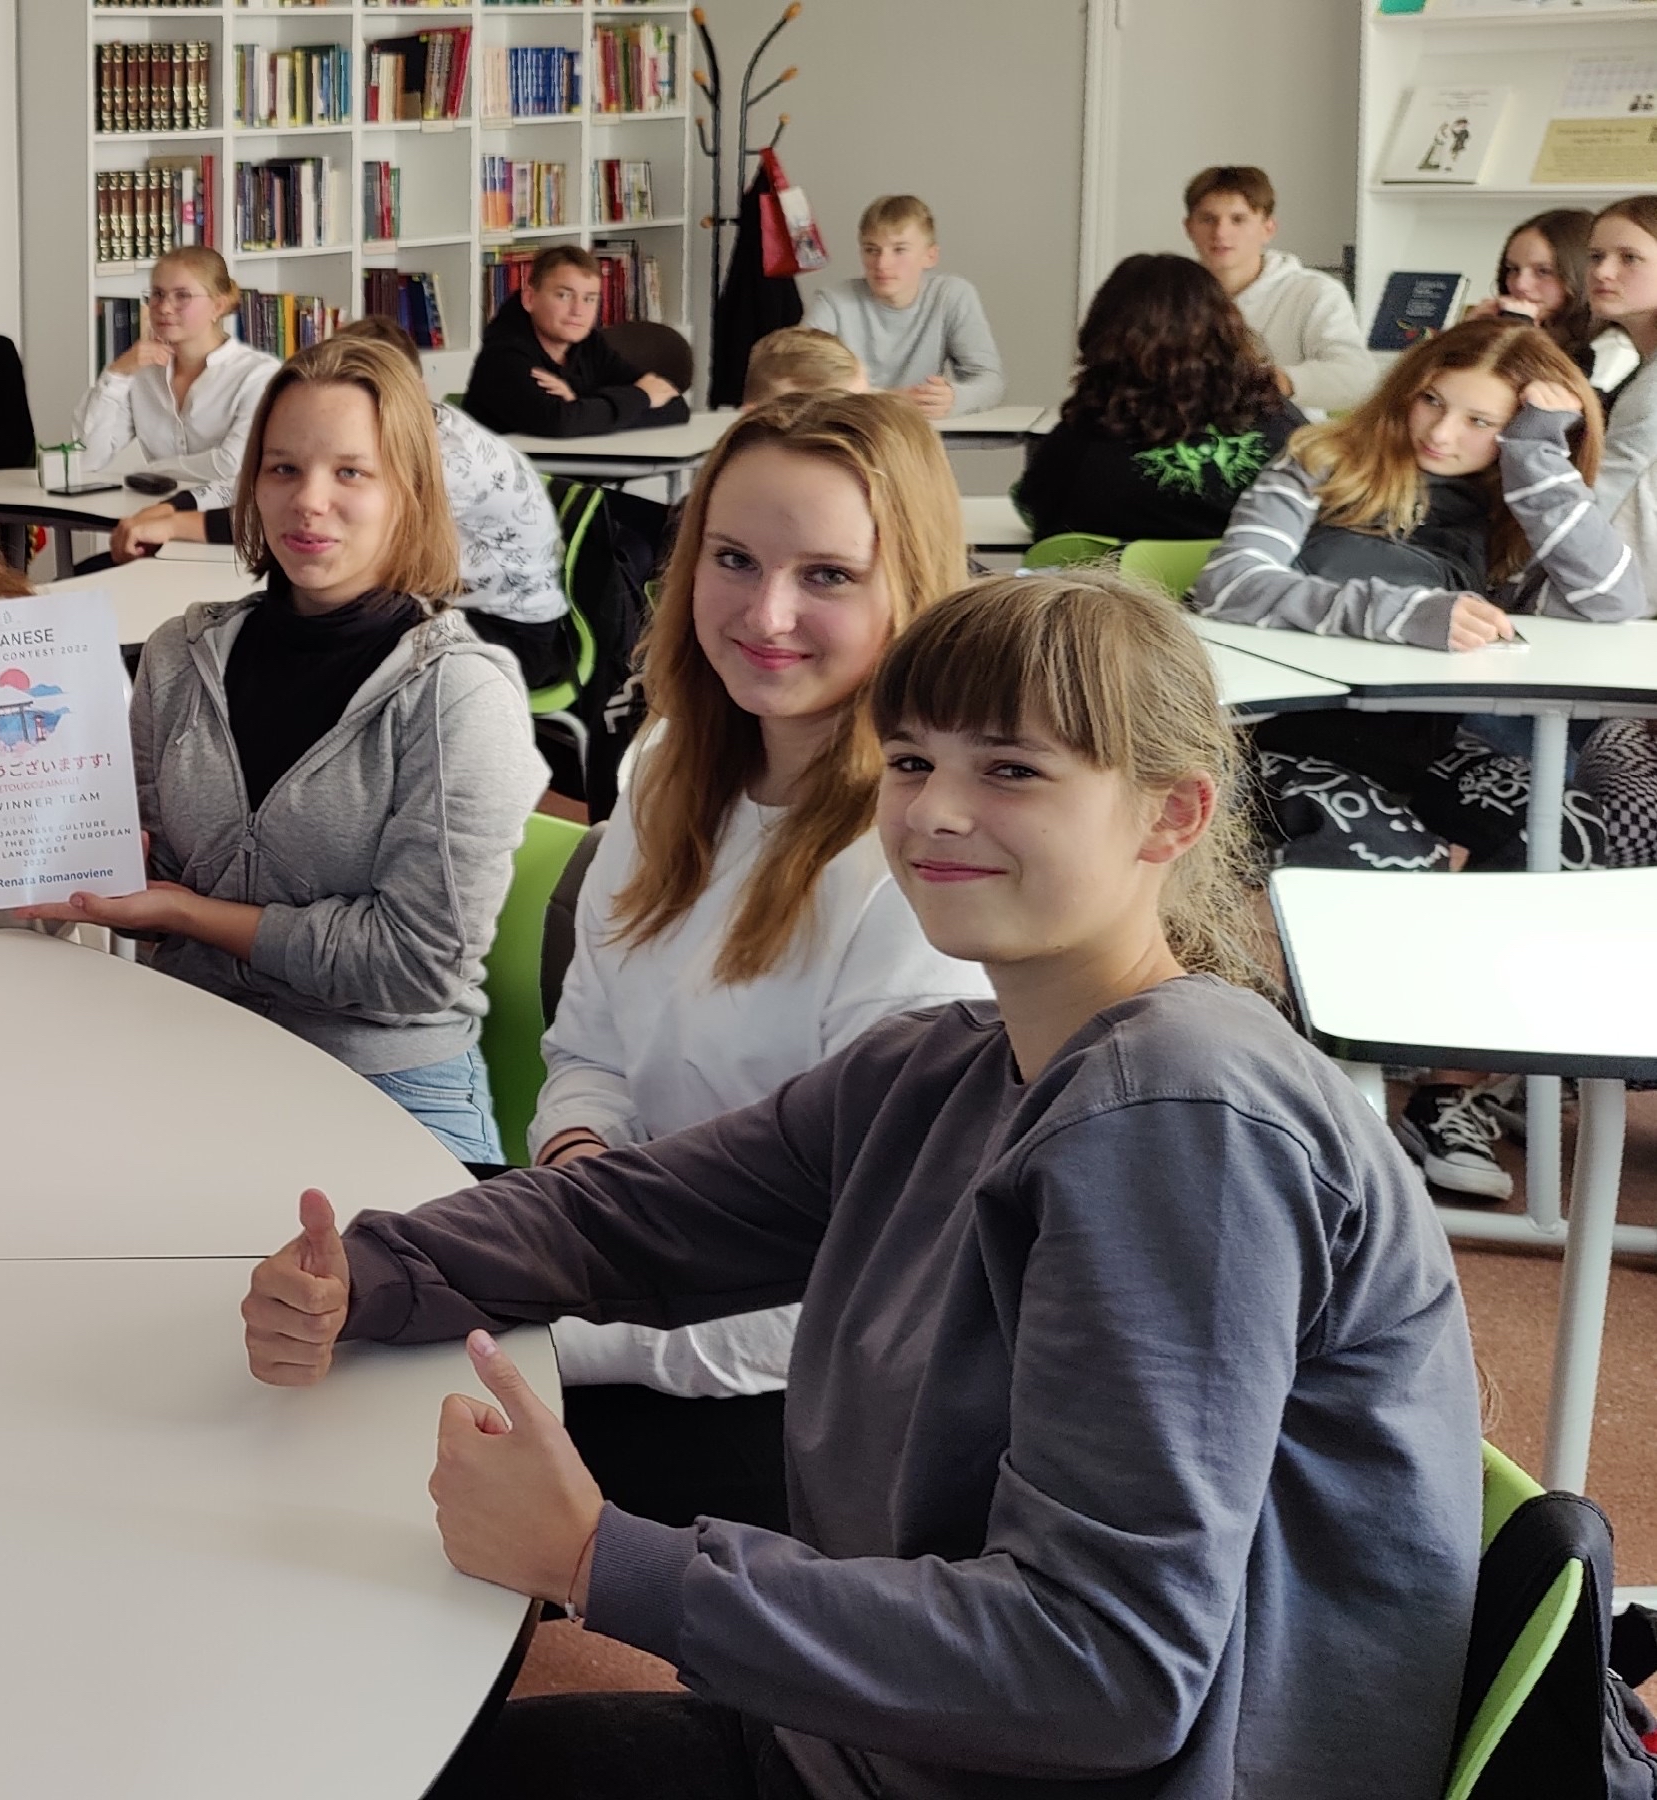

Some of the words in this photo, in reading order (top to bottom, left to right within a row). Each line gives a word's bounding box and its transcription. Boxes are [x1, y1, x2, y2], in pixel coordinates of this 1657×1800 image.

[2, 648, 55, 662] CONTEST
[60, 644, 89, 655] 2022
[62, 792, 101, 805] TEAM
[0, 826, 55, 838] JAPANESE
[58, 820, 107, 832] CULTURE
[4, 840, 24, 848] THE
[29, 837, 51, 846] DAY
[55, 835, 69, 843] OF
[72, 828, 132, 841] EUROPEAN
[2, 845, 67, 859] LANGUAGES
